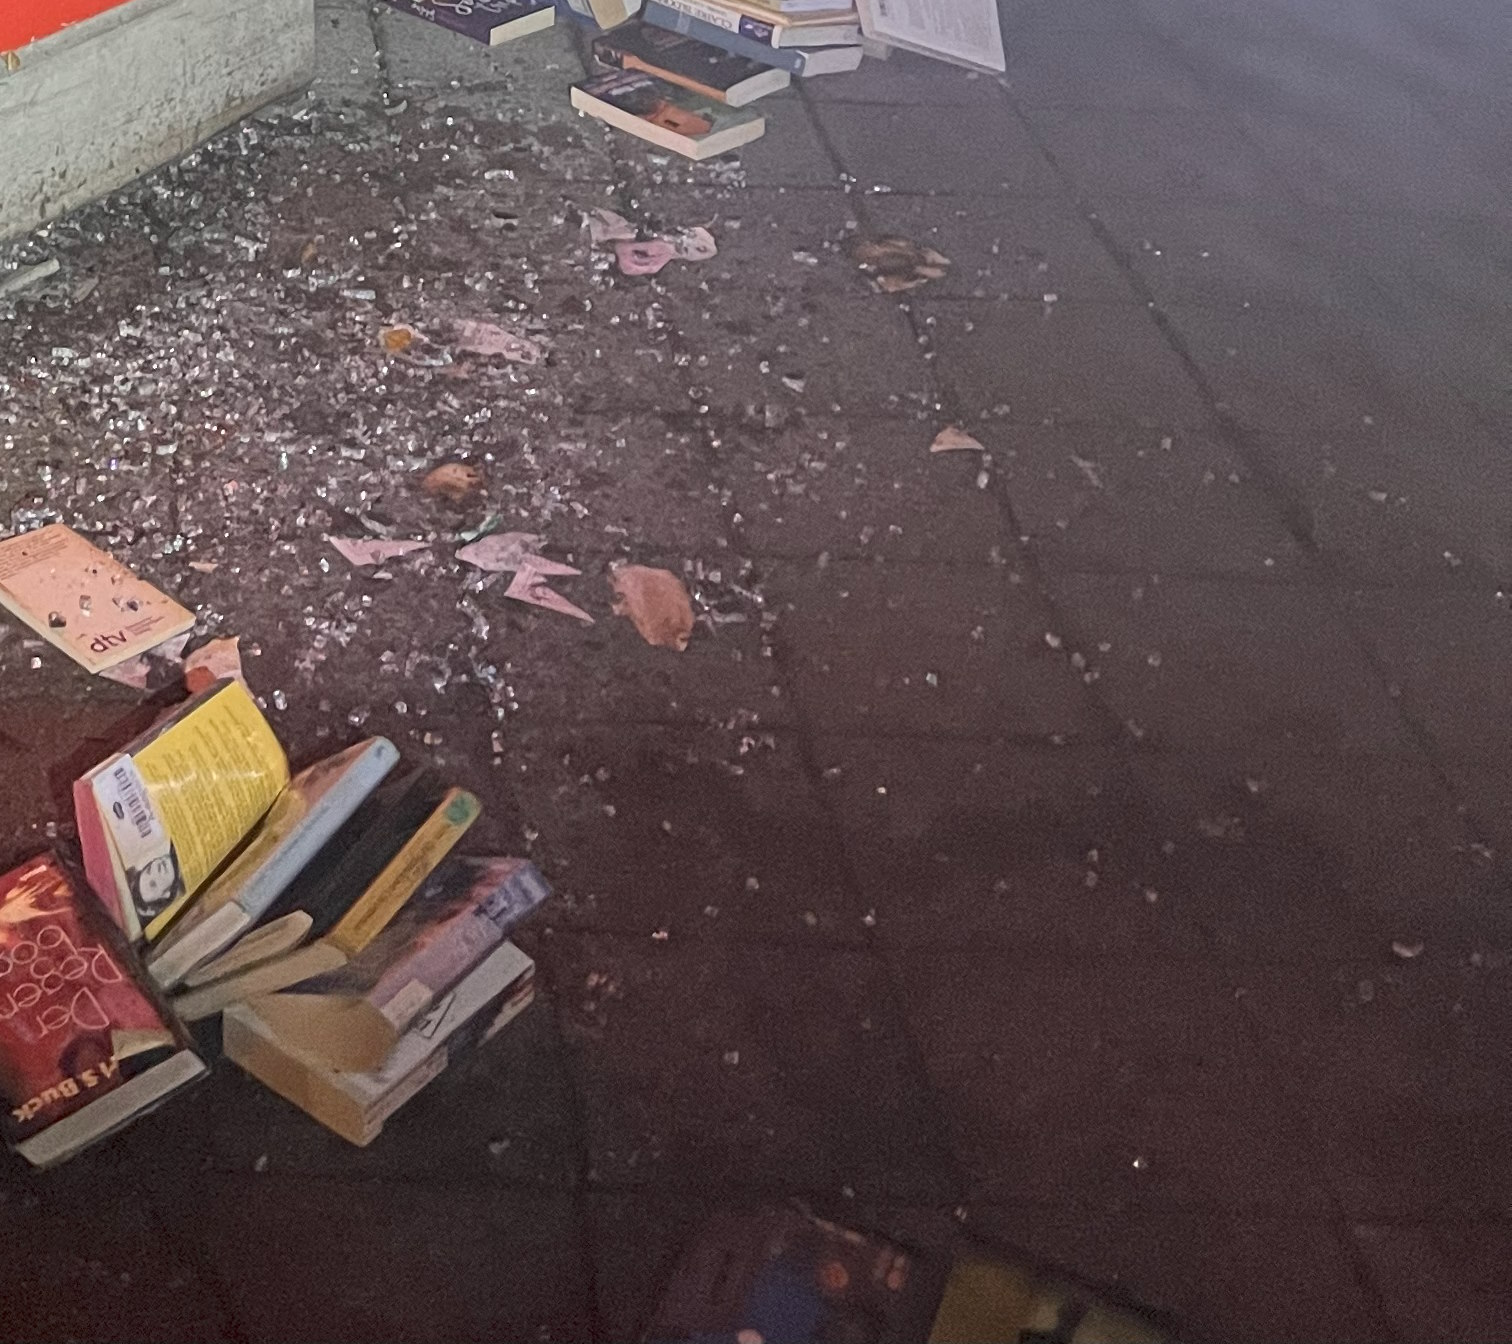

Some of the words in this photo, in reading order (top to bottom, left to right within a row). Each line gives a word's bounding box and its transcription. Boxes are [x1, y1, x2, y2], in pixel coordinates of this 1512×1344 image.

[90, 629, 127, 653] dtv
[36, 986, 110, 1039] Der
[11, 1077, 79, 1123] Buck
